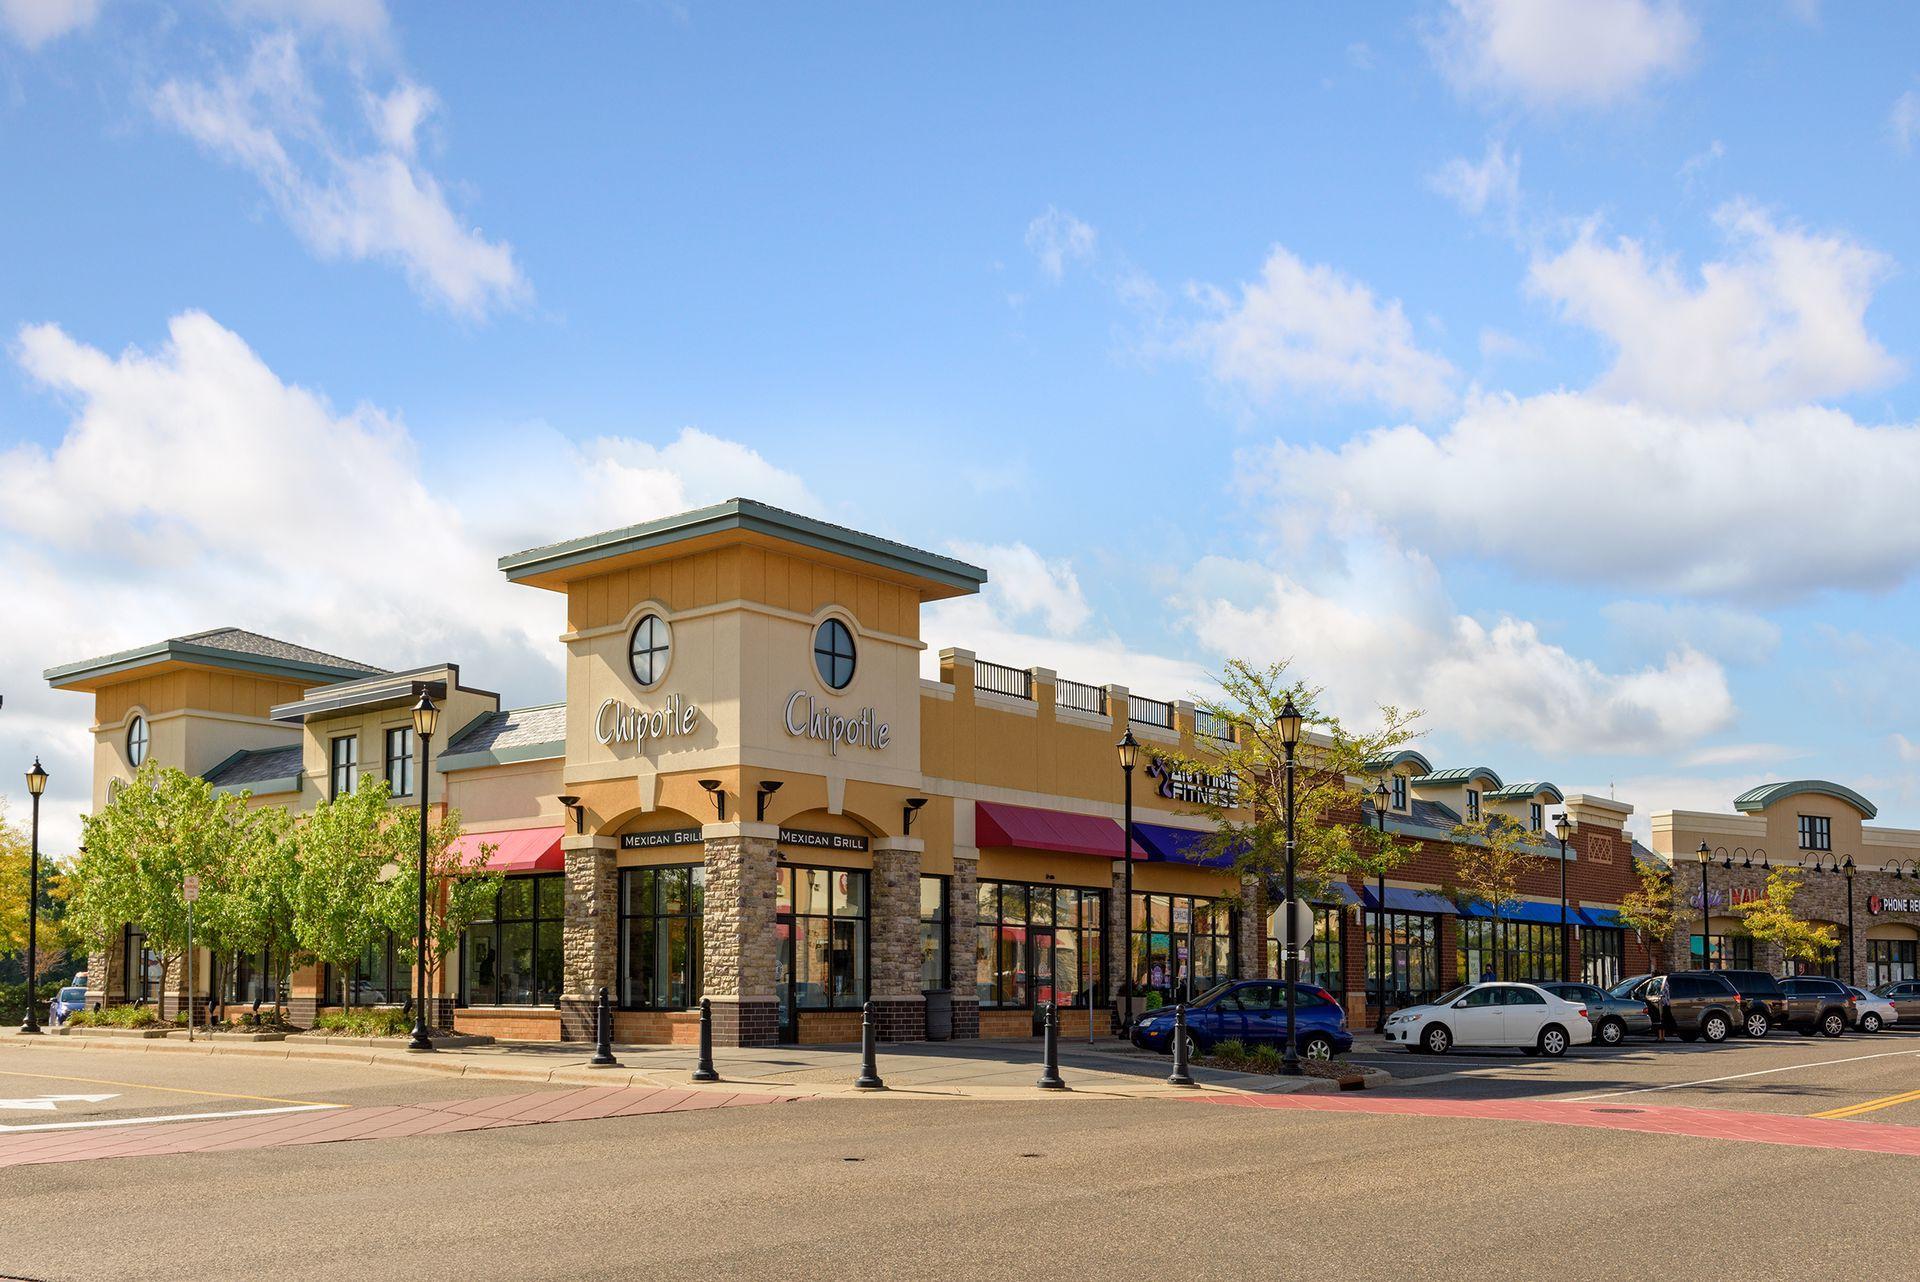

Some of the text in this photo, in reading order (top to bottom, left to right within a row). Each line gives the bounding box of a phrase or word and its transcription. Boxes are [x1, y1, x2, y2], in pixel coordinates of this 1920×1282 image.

[594, 694, 699, 754] Chipotle
[785, 689, 891, 757] Chipotle
[1173, 782, 1239, 809] FITNESS
[833, 836, 864, 849] GRILL
[1883, 898, 1920, 912] PHONE RE
